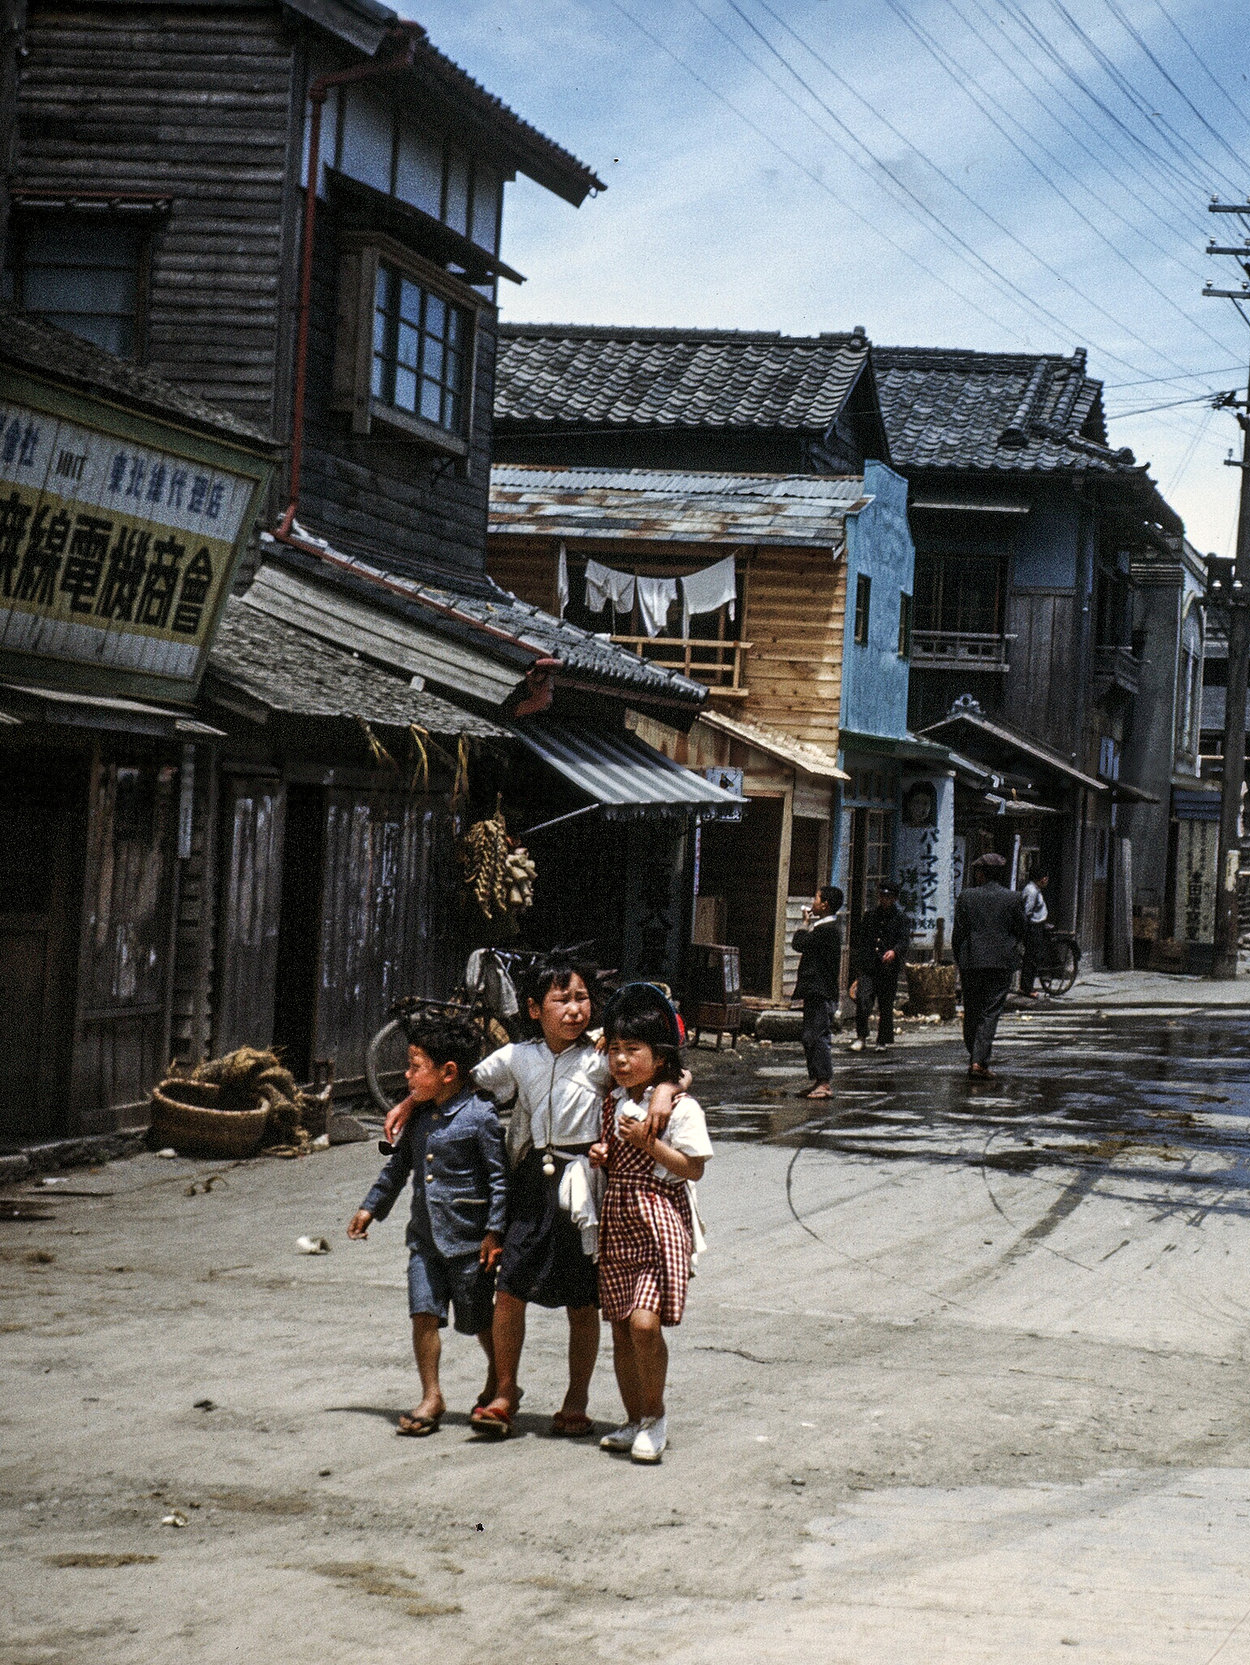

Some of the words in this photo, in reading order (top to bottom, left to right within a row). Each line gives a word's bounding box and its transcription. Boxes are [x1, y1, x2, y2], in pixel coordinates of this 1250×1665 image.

[920, 828, 940, 915] パーマネント
